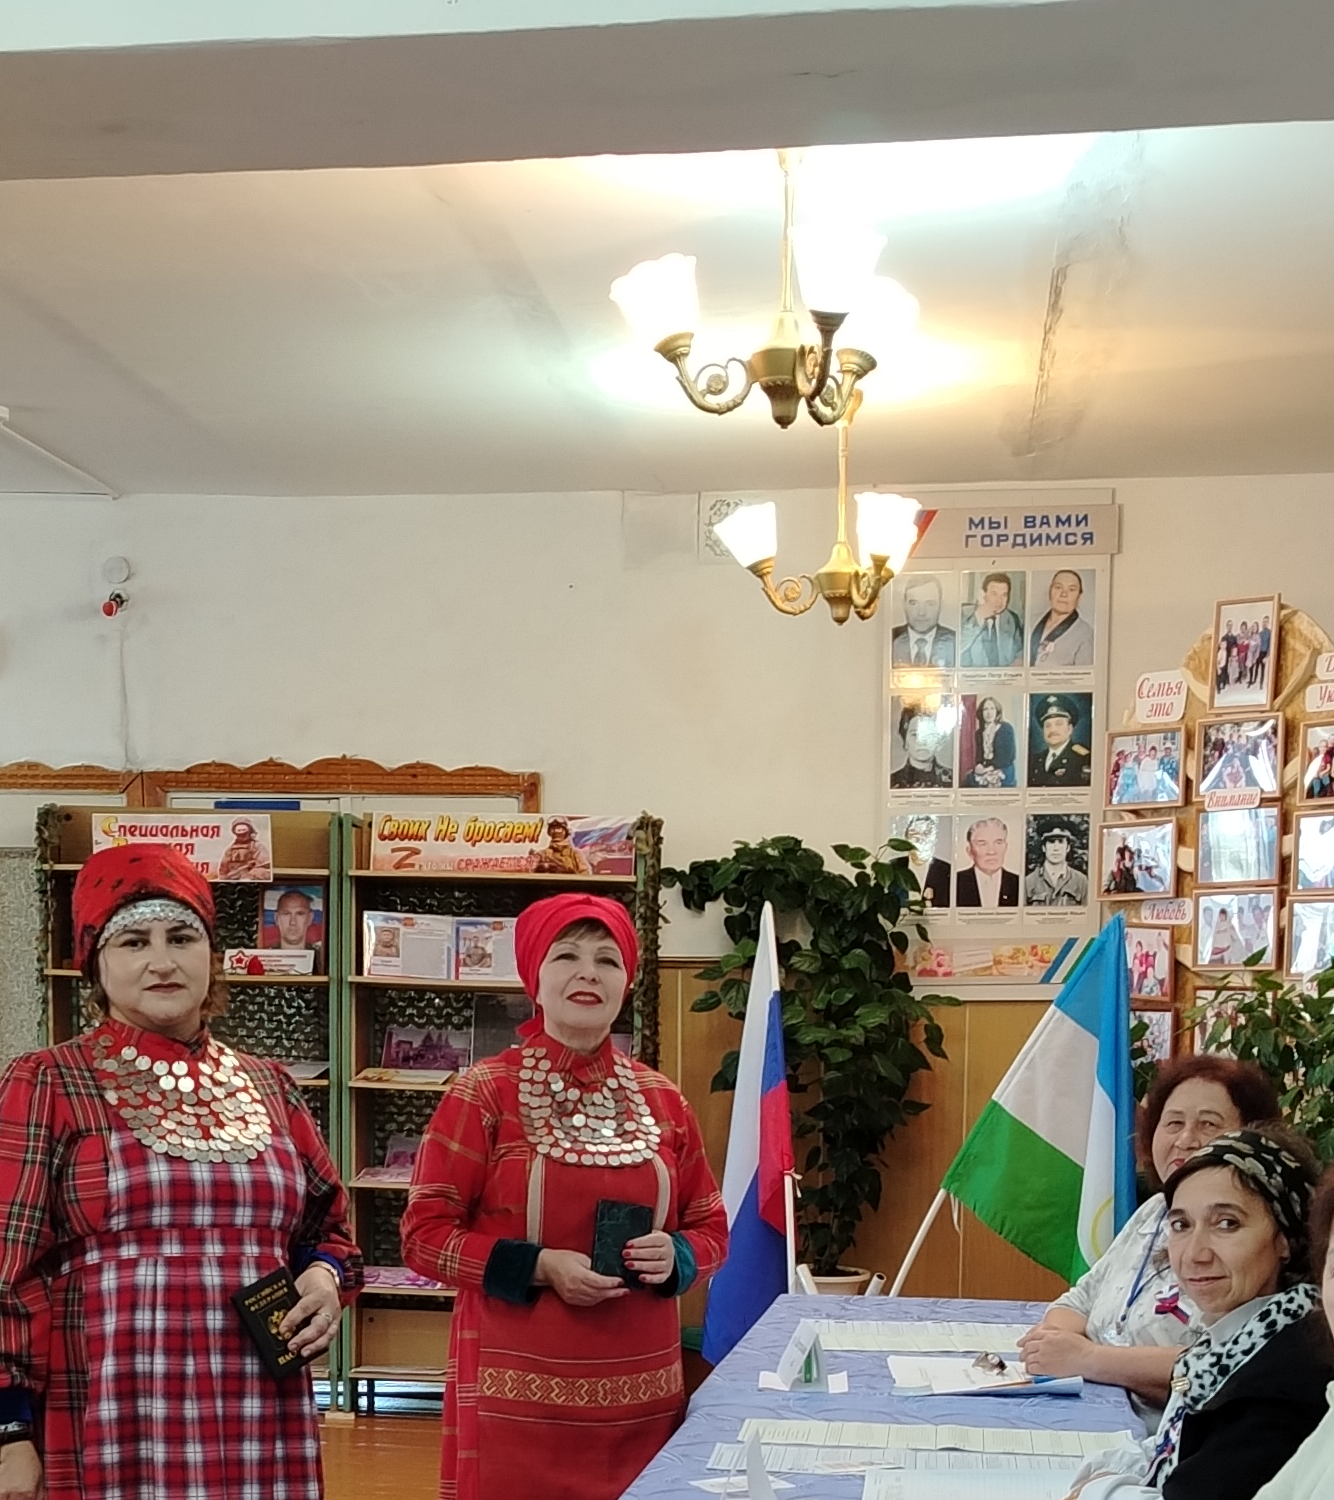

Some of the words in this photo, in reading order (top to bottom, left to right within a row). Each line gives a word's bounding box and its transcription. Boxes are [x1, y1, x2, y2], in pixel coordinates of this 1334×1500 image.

[969, 516, 1008, 531] МЫ
[1024, 513, 1089, 529] ВАМИ
[965, 532, 1094, 549] ГОРДИМСЯ
[1137, 677, 1184, 700] Семья
[1145, 701, 1175, 720] это
[1206, 789, 1259, 808] Внимание
[101, 816, 220, 838] Специальная
[378, 814, 432, 843] Своих
[433, 815, 459, 842] Не
[462, 817, 544, 848] бросаем!
[1147, 901, 1187, 923] Любовь
